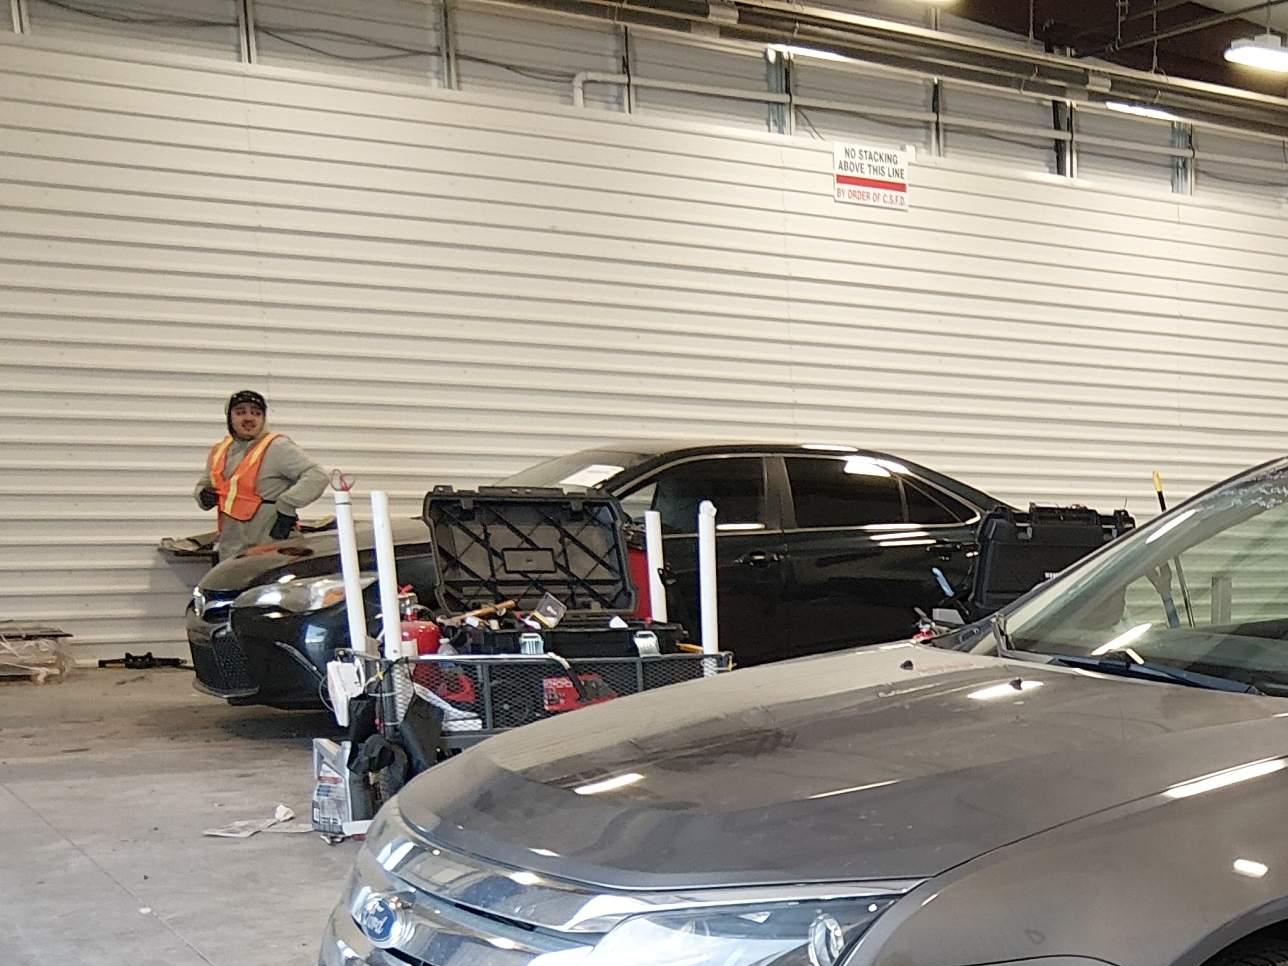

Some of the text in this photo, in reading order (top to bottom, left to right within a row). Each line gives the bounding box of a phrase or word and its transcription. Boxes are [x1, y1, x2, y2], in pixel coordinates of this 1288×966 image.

[844, 147, 898, 165] NO STACKING
[838, 160, 904, 179] ABOVE THIS LINE
[837, 188, 845, 198] BY
[847, 189, 871, 201] ORDER
[872, 192, 881, 203] OF
